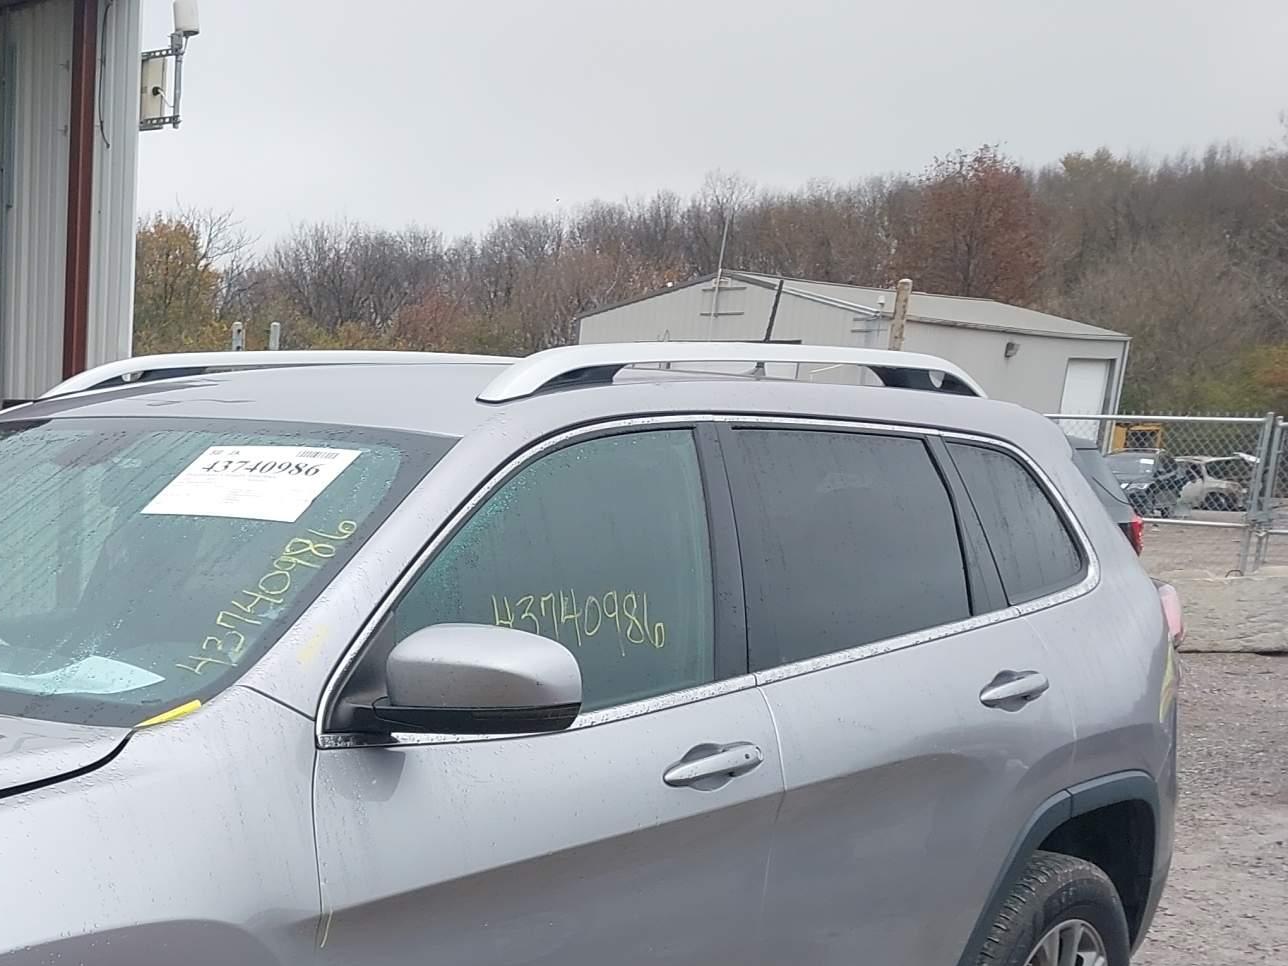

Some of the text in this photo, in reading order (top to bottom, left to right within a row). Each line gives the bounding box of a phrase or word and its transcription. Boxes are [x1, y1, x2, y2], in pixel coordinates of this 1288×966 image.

[202, 460, 322, 477] 43740986
[176, 520, 357, 675] 43740986
[492, 588, 665, 656] 43740986
